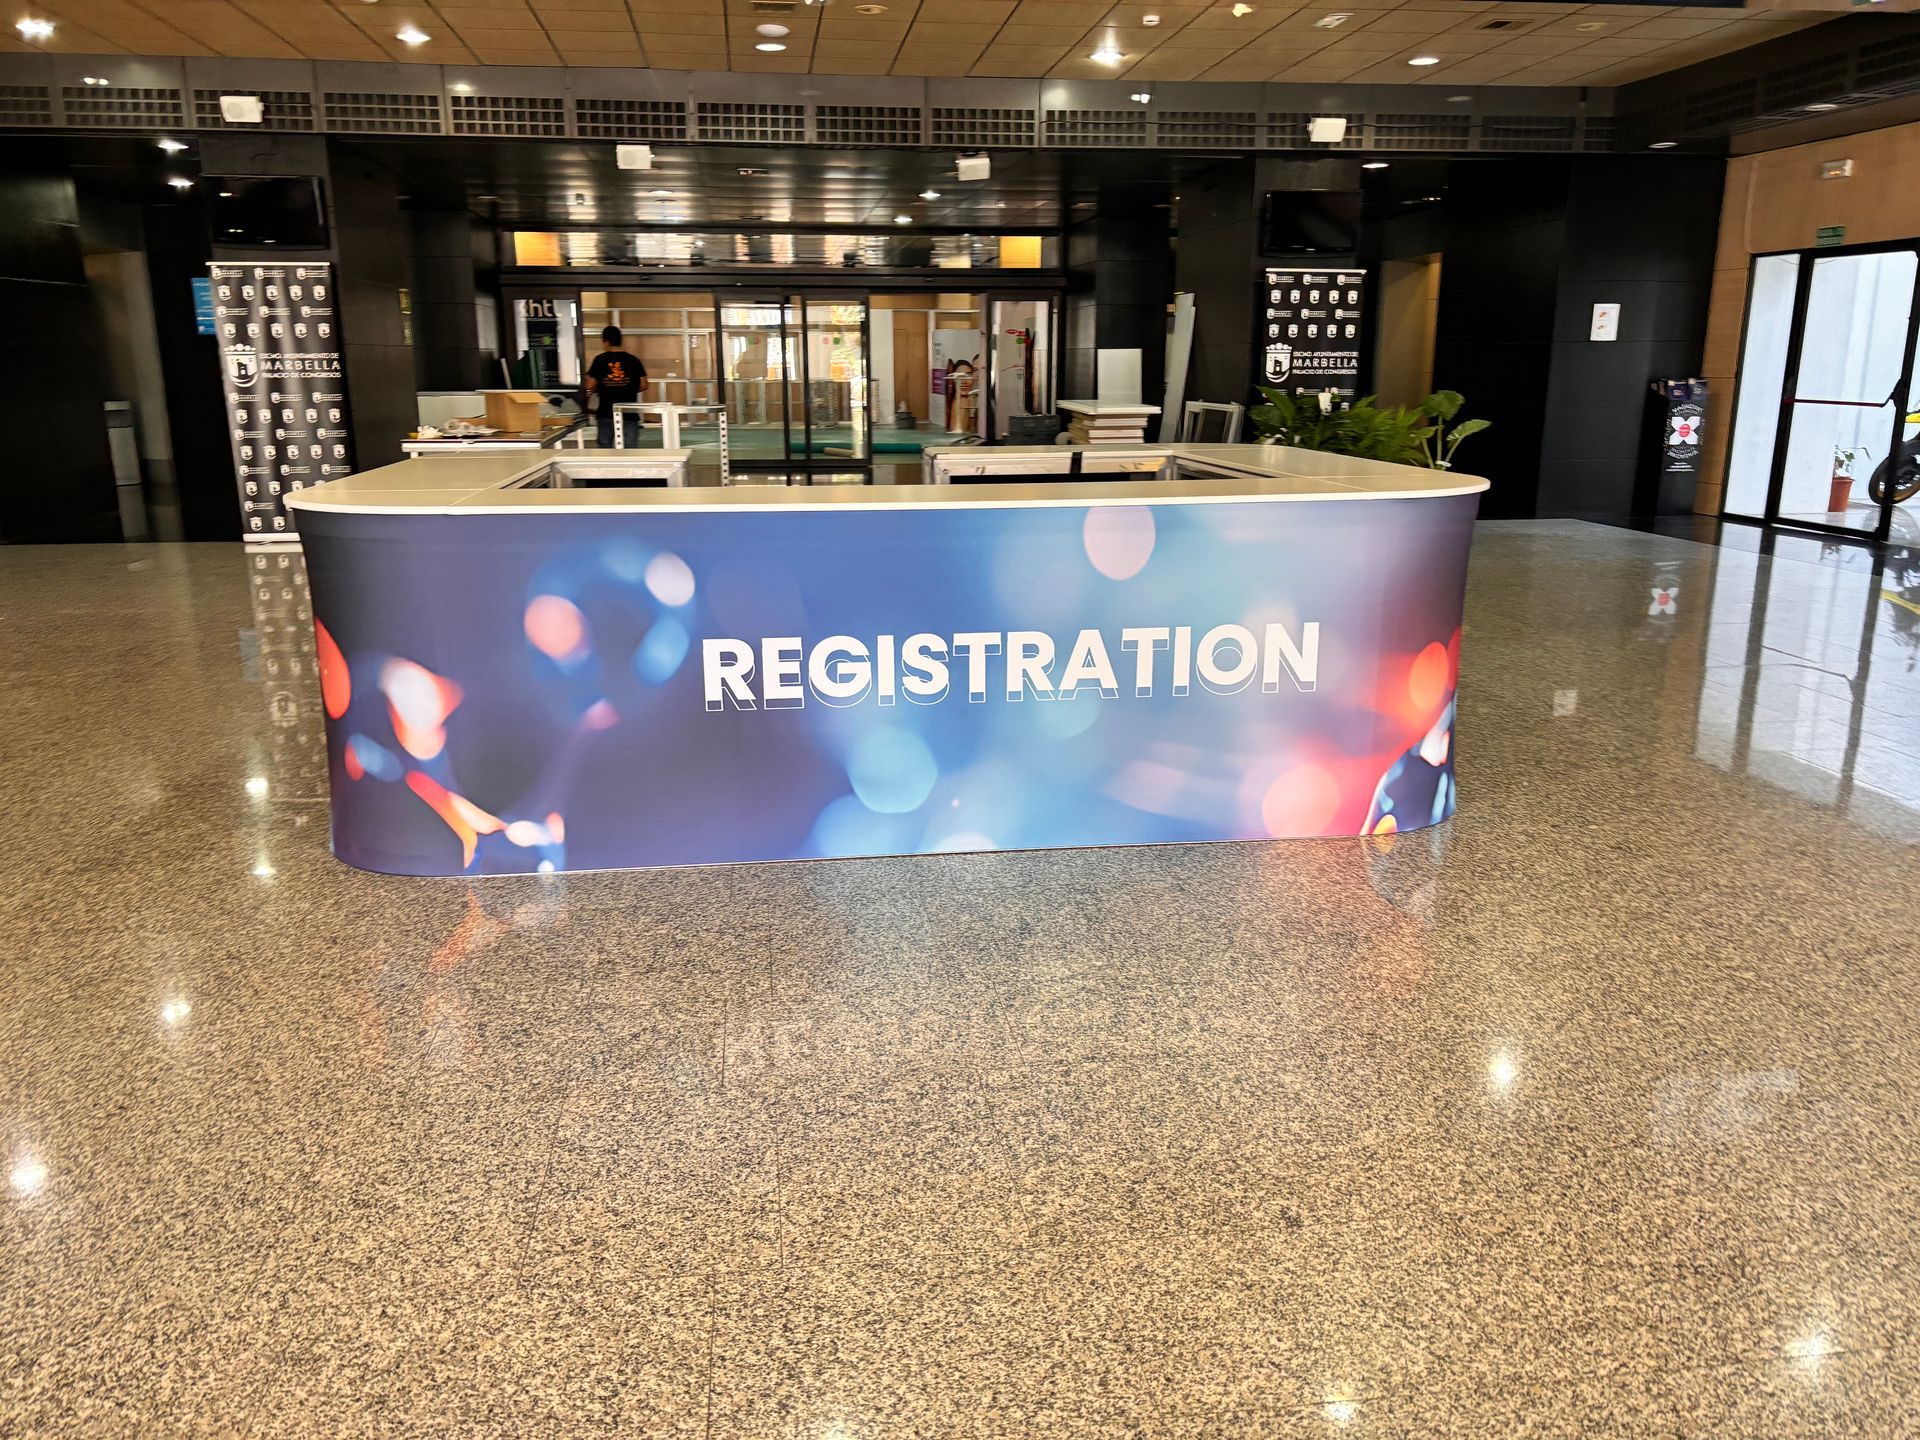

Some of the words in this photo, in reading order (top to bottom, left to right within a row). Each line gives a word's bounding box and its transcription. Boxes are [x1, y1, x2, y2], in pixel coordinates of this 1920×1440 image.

[260, 360, 341, 370] MARBELLA
[1292, 358, 1358, 367] MARBELLA
[702, 621, 1320, 712] REGISTRATION
